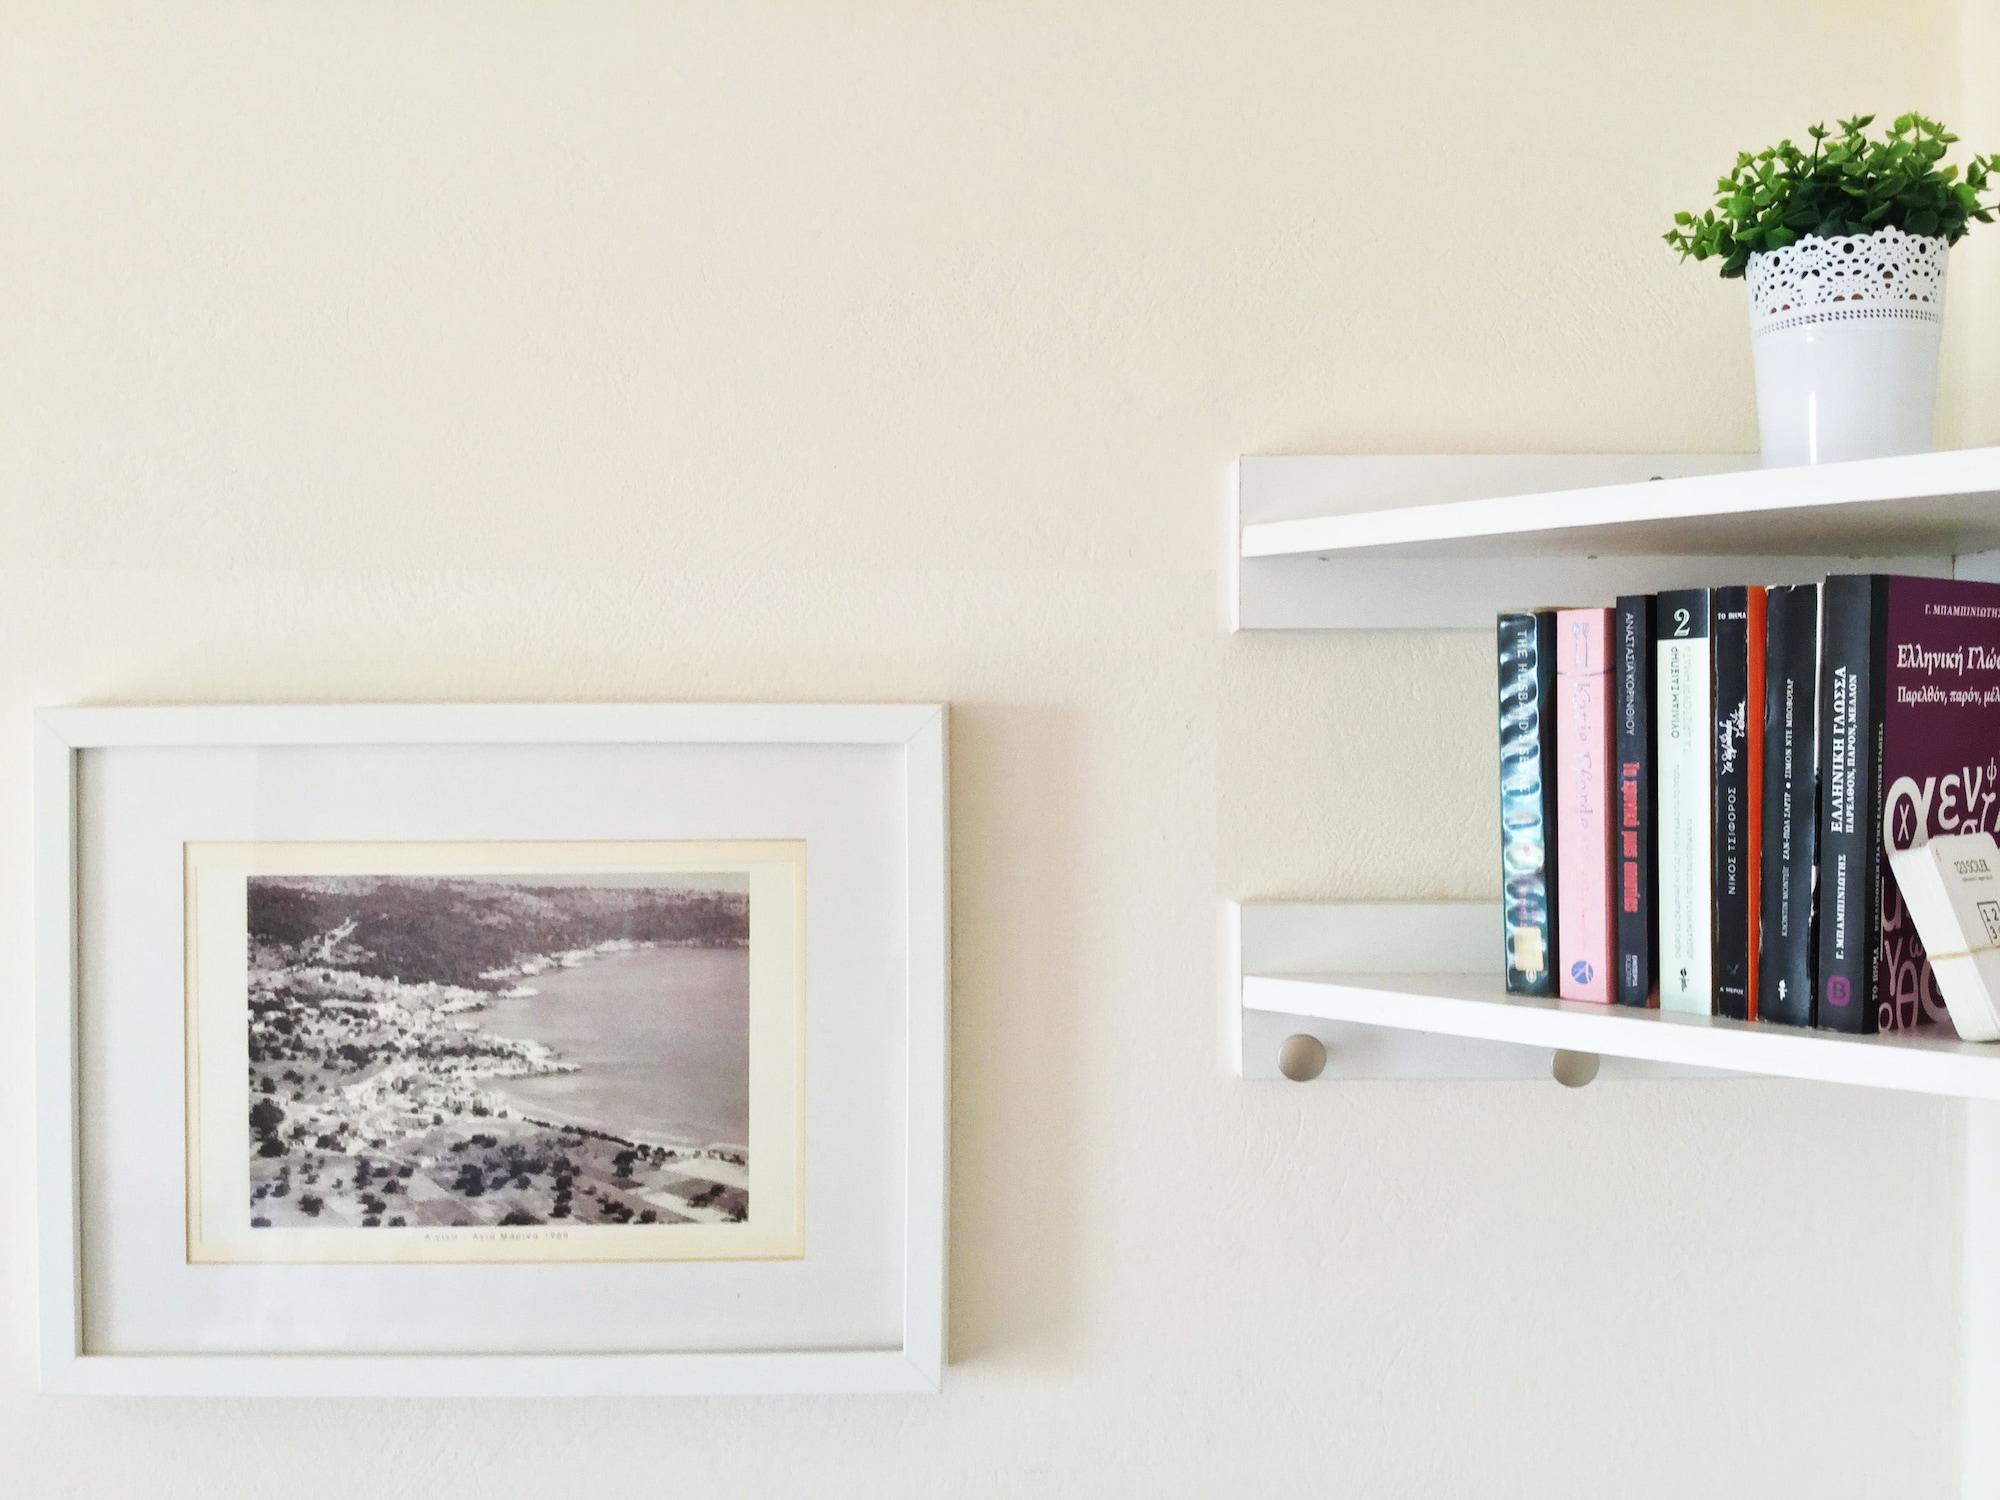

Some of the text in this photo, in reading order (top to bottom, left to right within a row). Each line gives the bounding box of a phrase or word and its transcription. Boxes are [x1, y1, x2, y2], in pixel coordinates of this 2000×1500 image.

[1674, 608, 1690, 637] 2
[1517, 629, 1529, 658] THE
[1625, 612, 1637, 736] ΑΝΑΣΤΑΣΙΑ ΚΟΡΙΝΘΙΟΥ
[1896, 643, 1964, 676] Ελληνική
[1897, 685, 1948, 708] Παρελθόν,
[1950, 686, 1981, 708] παρόν,
[1785, 729, 1793, 747] ΝΤΕ
[1830, 665, 1847, 834] ΕΛΛΗΝΙΚΗ ΓΛΩΣΣΑ
[1845, 673, 1858, 834] ΠΑΡΕΛΘΟΝ, ΠΑΡΟΝ, ΜΕΛΛΟΝ
[1784, 748, 1793, 779] ΣΙΜΟΝ
[1783, 791, 1792, 819] ΣΑΡΤΡ
[1727, 787, 1737, 895] ΝΙΚΟΣ ΤΣΙΦΟΡΟΣ
[1836, 854, 1846, 949] ΜΠΑΜΠΙΝΙΩΤΗΣ
[1872, 985, 1880, 1001] ΤΟ
